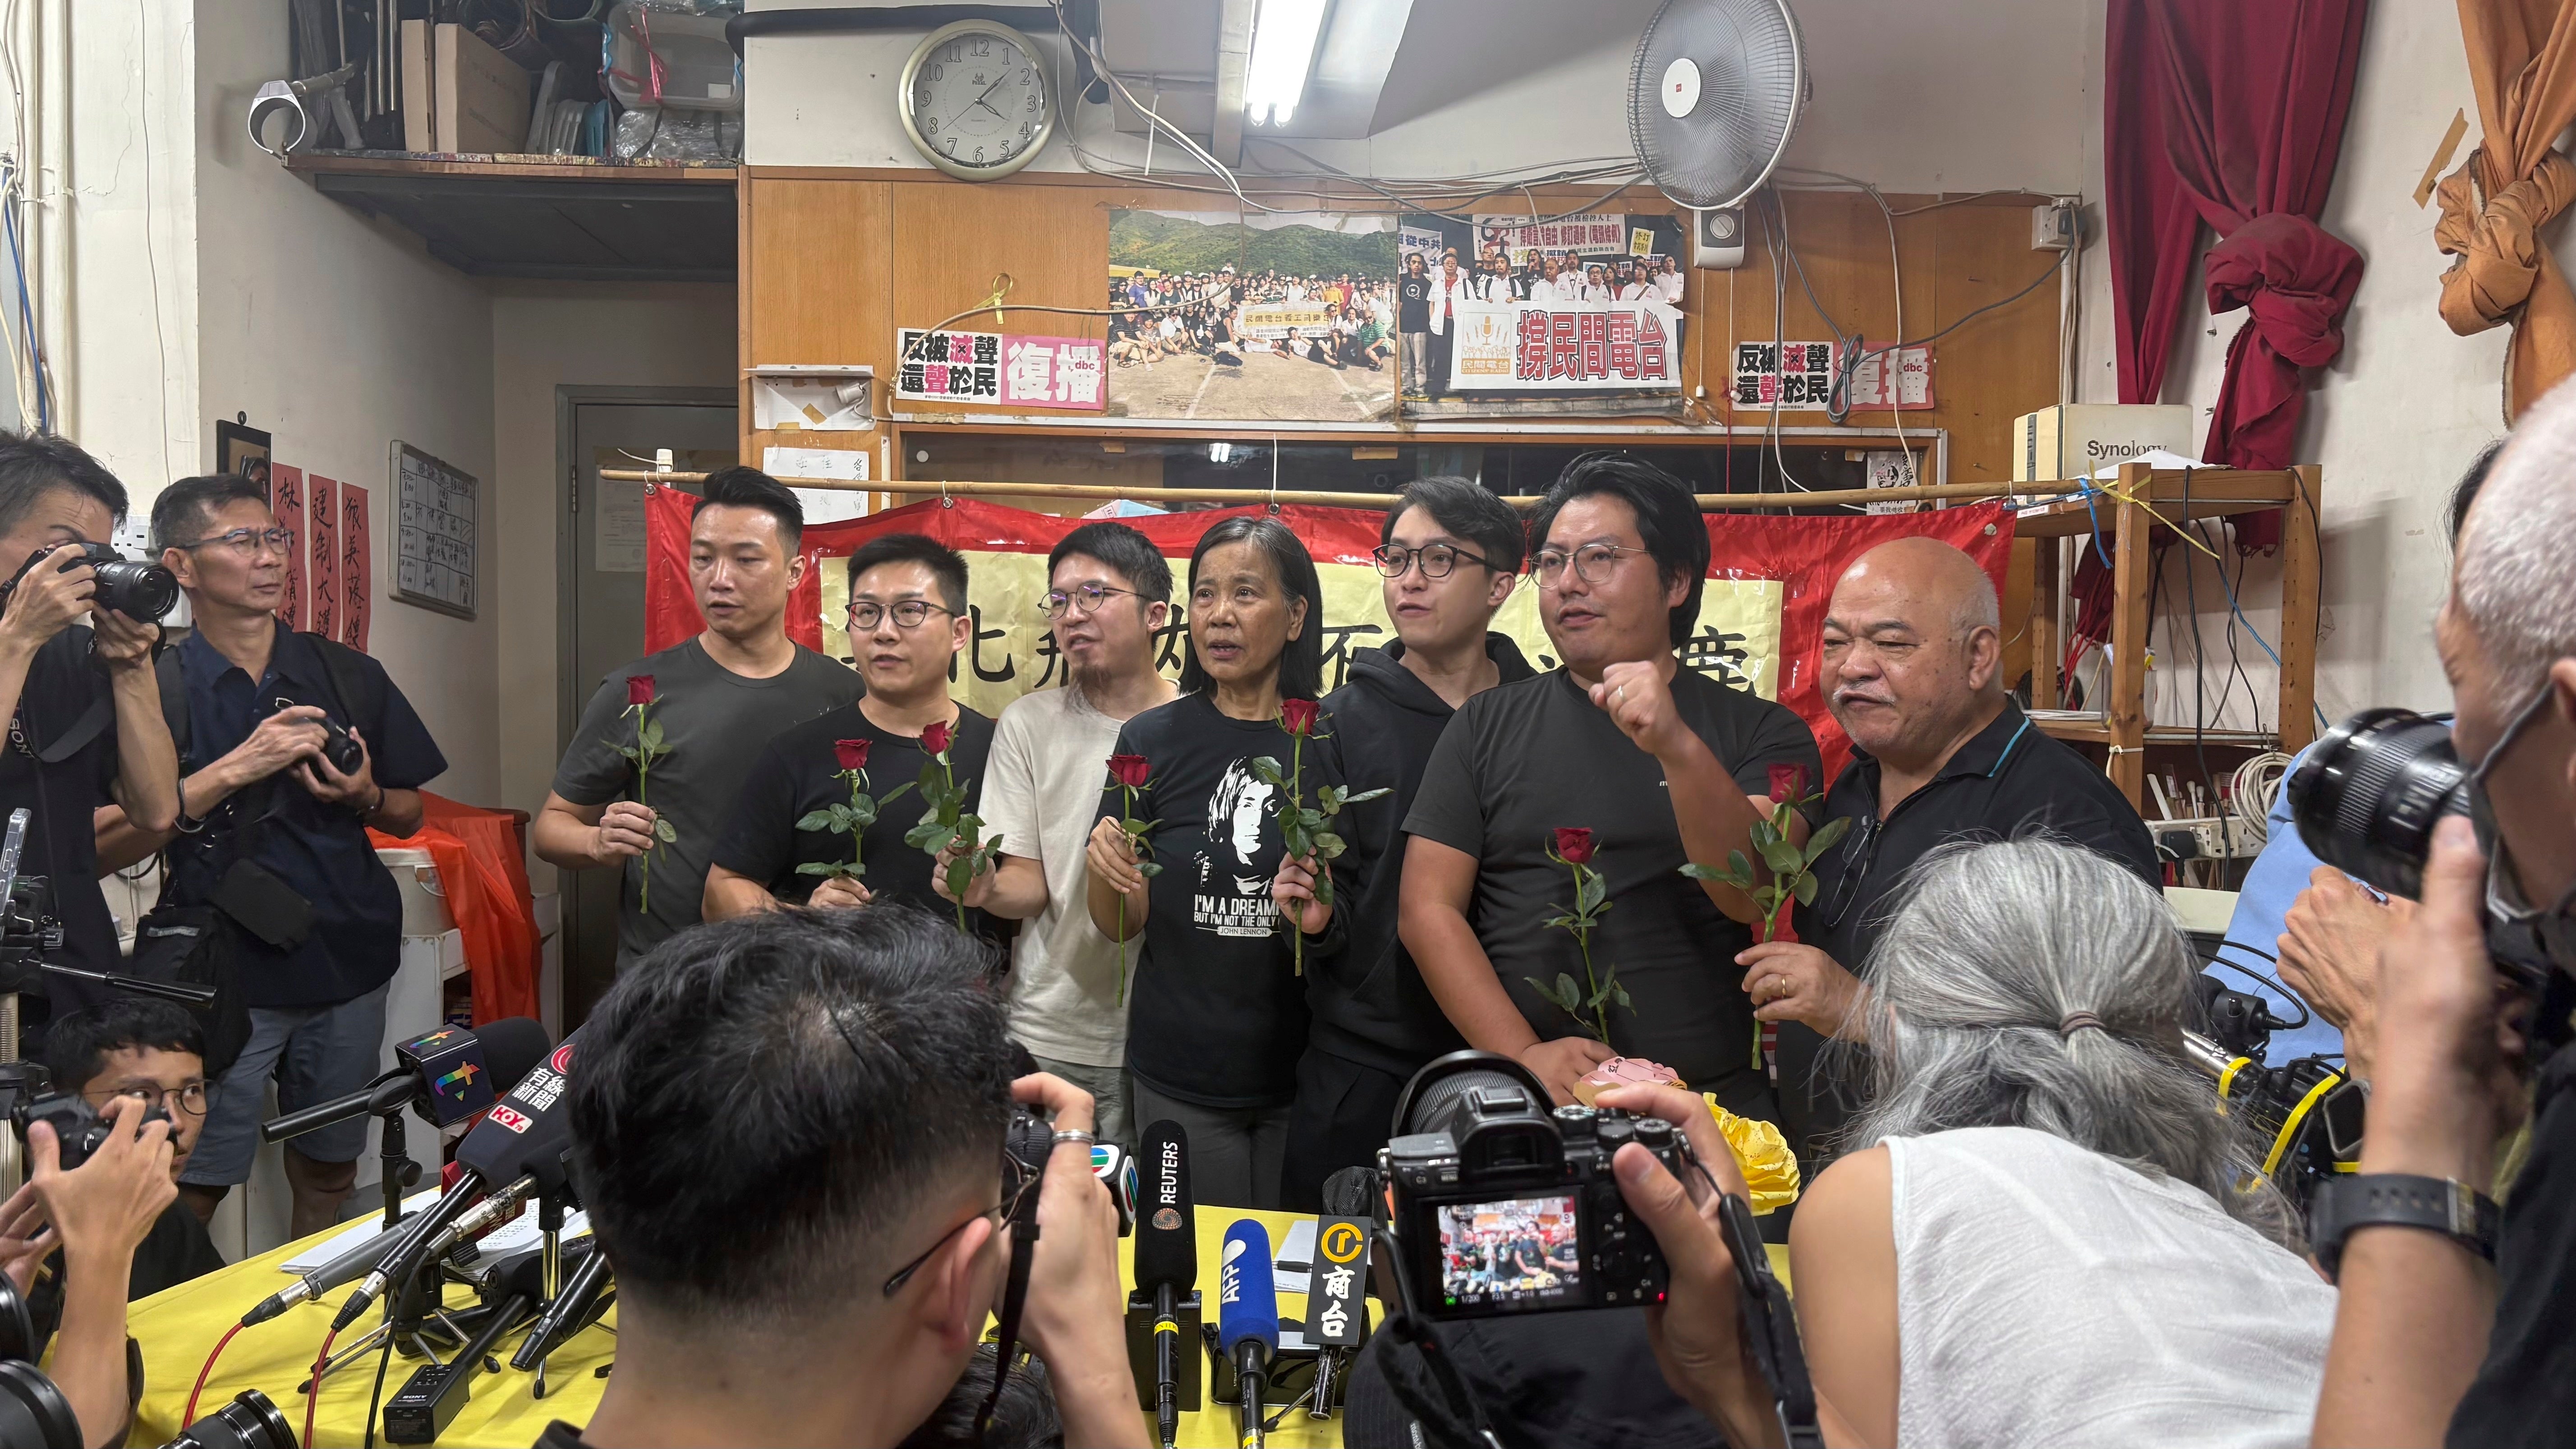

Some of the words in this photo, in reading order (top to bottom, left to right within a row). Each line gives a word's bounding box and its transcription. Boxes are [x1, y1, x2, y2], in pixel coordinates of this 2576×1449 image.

[946, 46, 961, 62] 11
[971, 40, 989, 56] 12
[1003, 48, 1010, 64] 1
[925, 64, 943, 81] 10
[1020, 69, 1030, 85] 2
[921, 91, 931, 106] 9
[1027, 96, 1036, 112] 3
[928, 118, 938, 134] 8
[1019, 122, 1029, 138] 4
[947, 138, 957, 155] 7
[1000, 141, 1009, 157] 5
[973, 147, 983, 163] 6
[1517, 308, 1668, 381] 撐民間電台
[1007, 342, 1100, 403] 復播
[1075, 361, 1095, 370] dbc
[1903, 363, 1923, 372] dbc
[901, 363, 997, 396] 還聲於民
[1737, 375, 1829, 404] 還聲於民
[1195, 894, 1214, 913] I'M
[1218, 897, 1226, 914] A
[1194, 911, 1208, 923] BUT
[1210, 914, 1222, 925] I'M
[1224, 915, 1238, 926] NOT
[1242, 915, 1255, 926] THE
[1257, 916, 1275, 927] ONLY
[529, 1067, 566, 1096] 有線
[512, 1082, 557, 1112] 新聞
[492, 1107, 525, 1127] HOY
[1160, 1141, 1178, 1204] REUTERS
[1222, 1264, 1239, 1305] AFP
[1321, 1265, 1355, 1337] 商台
